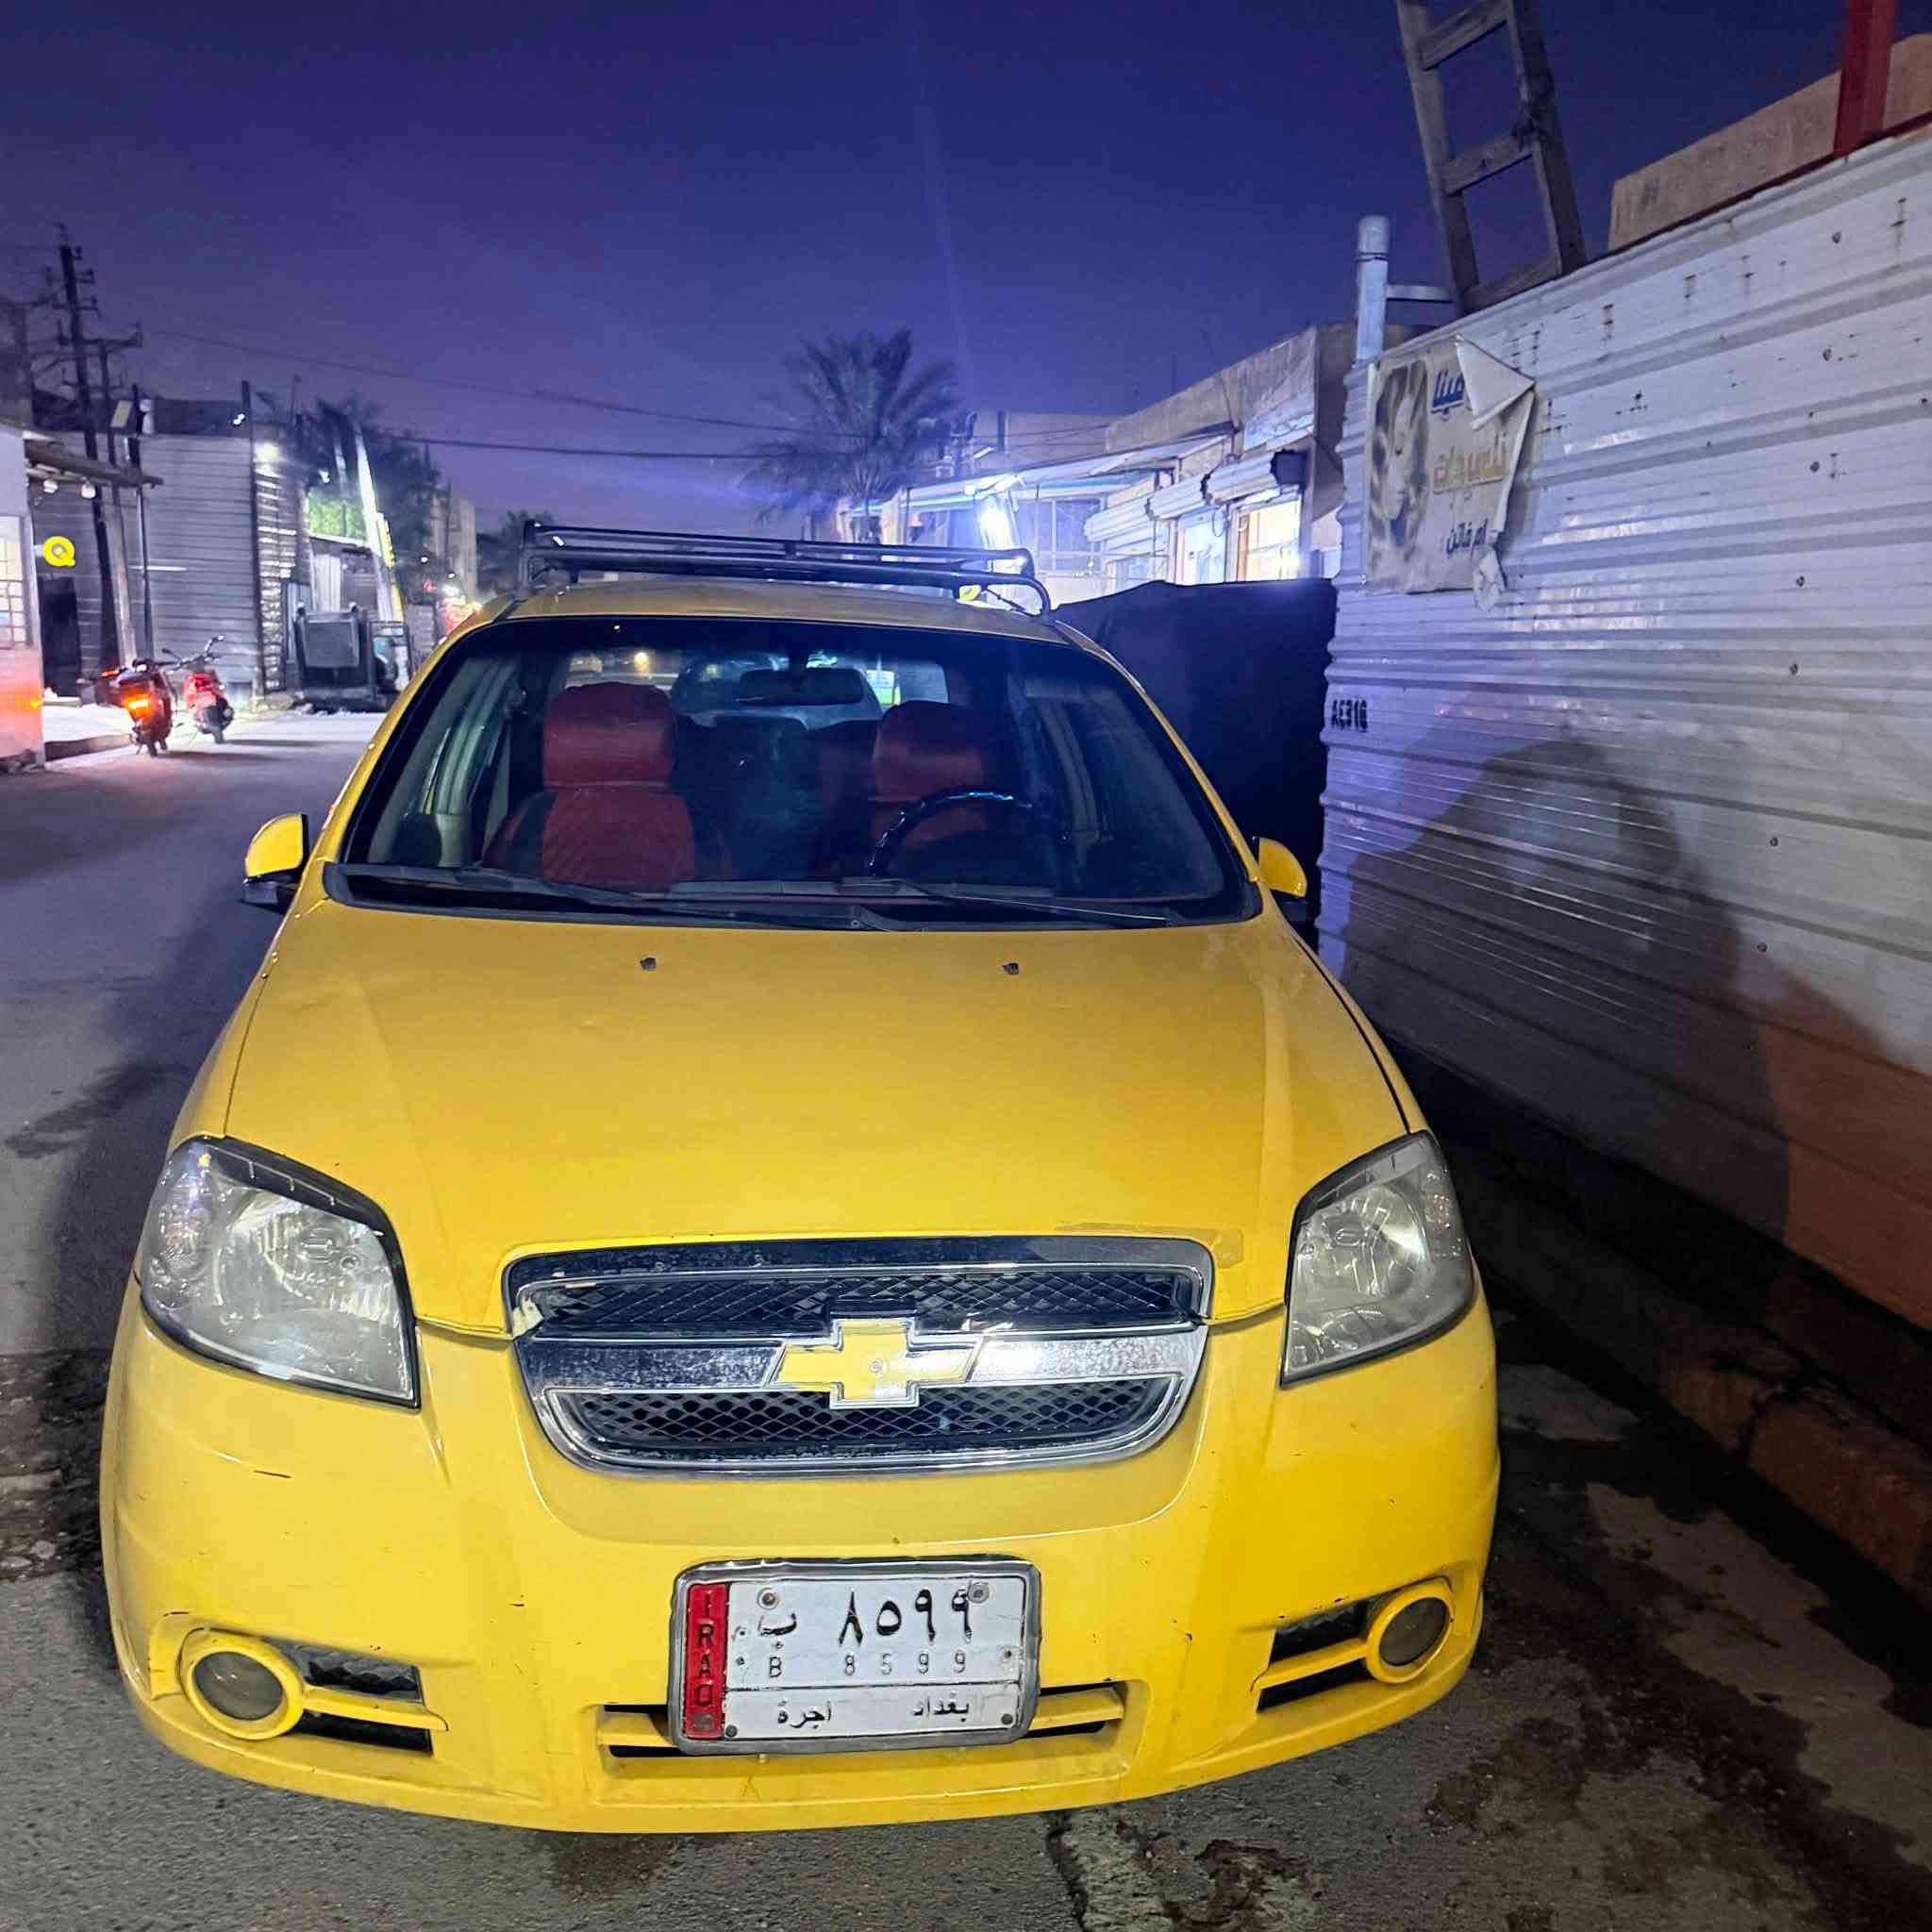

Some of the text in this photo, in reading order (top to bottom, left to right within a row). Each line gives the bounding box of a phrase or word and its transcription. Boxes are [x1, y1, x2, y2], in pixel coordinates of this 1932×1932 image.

[839, 1590, 973, 1644] ٨٥٩٩
[768, 1651, 966, 1678] B 8599
[912, 1690, 970, 1723] بغداد
